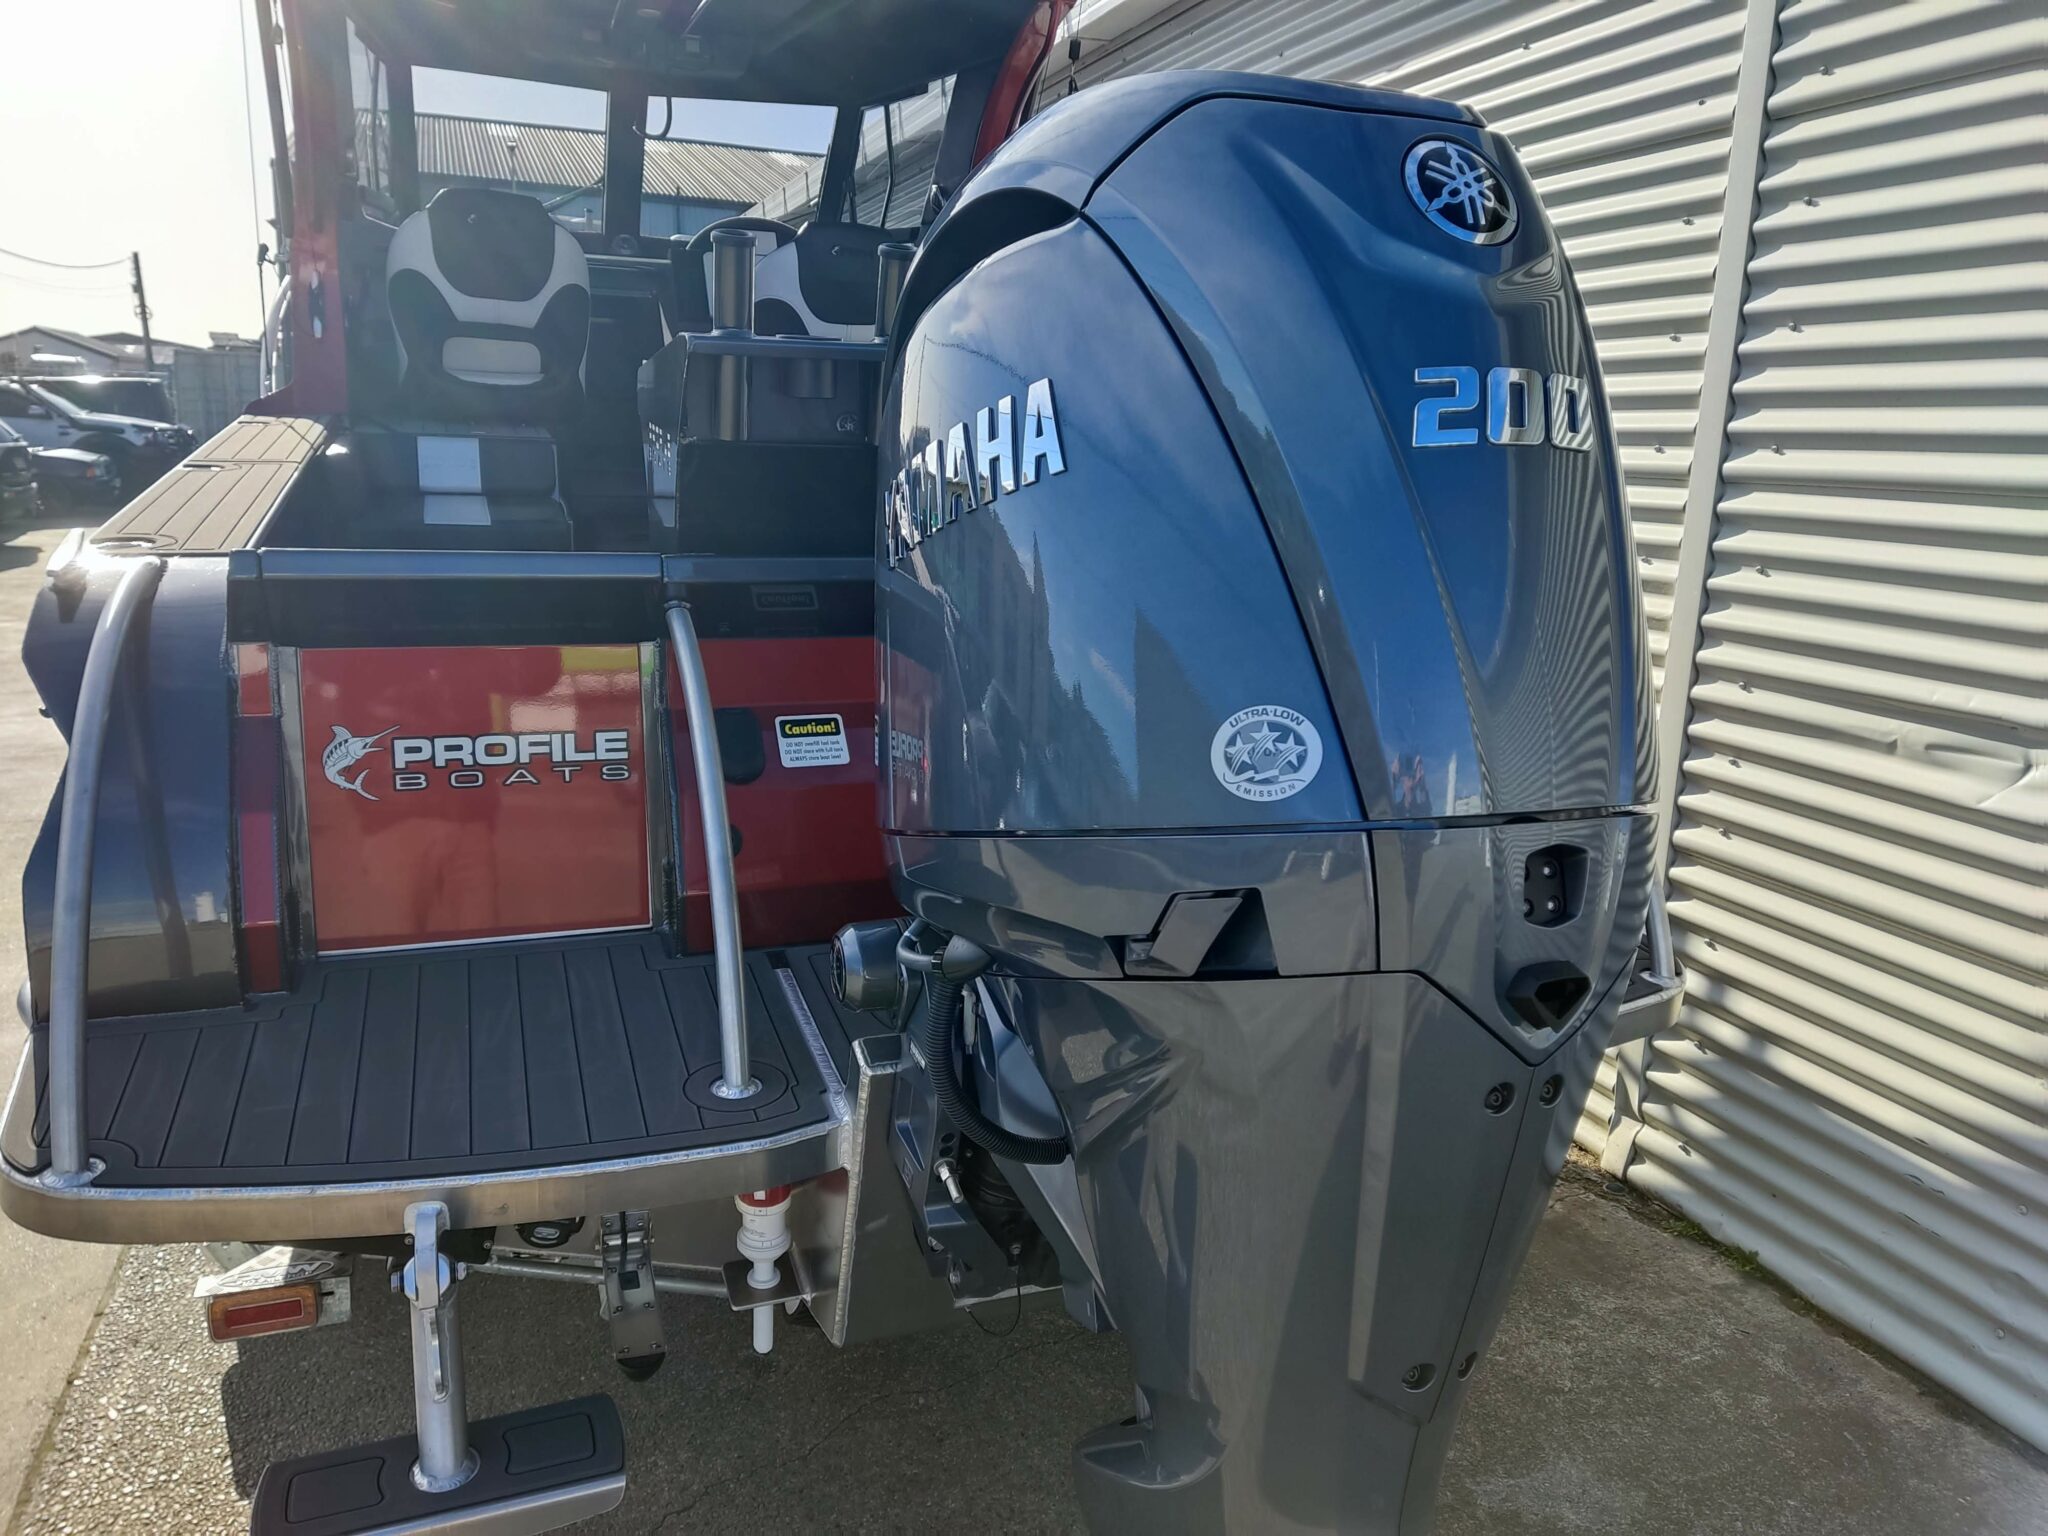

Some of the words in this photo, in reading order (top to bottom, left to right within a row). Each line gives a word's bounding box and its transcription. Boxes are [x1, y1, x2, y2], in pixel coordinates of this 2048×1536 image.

[1413, 366, 1594, 450] 200
[884, 377, 1067, 568] YAMAHA
[784, 721, 837, 735] Caution!
[393, 730, 628, 768] PROFILE
[395, 764, 630, 790] BOATS
[1236, 783, 1296, 797] EMISSION
